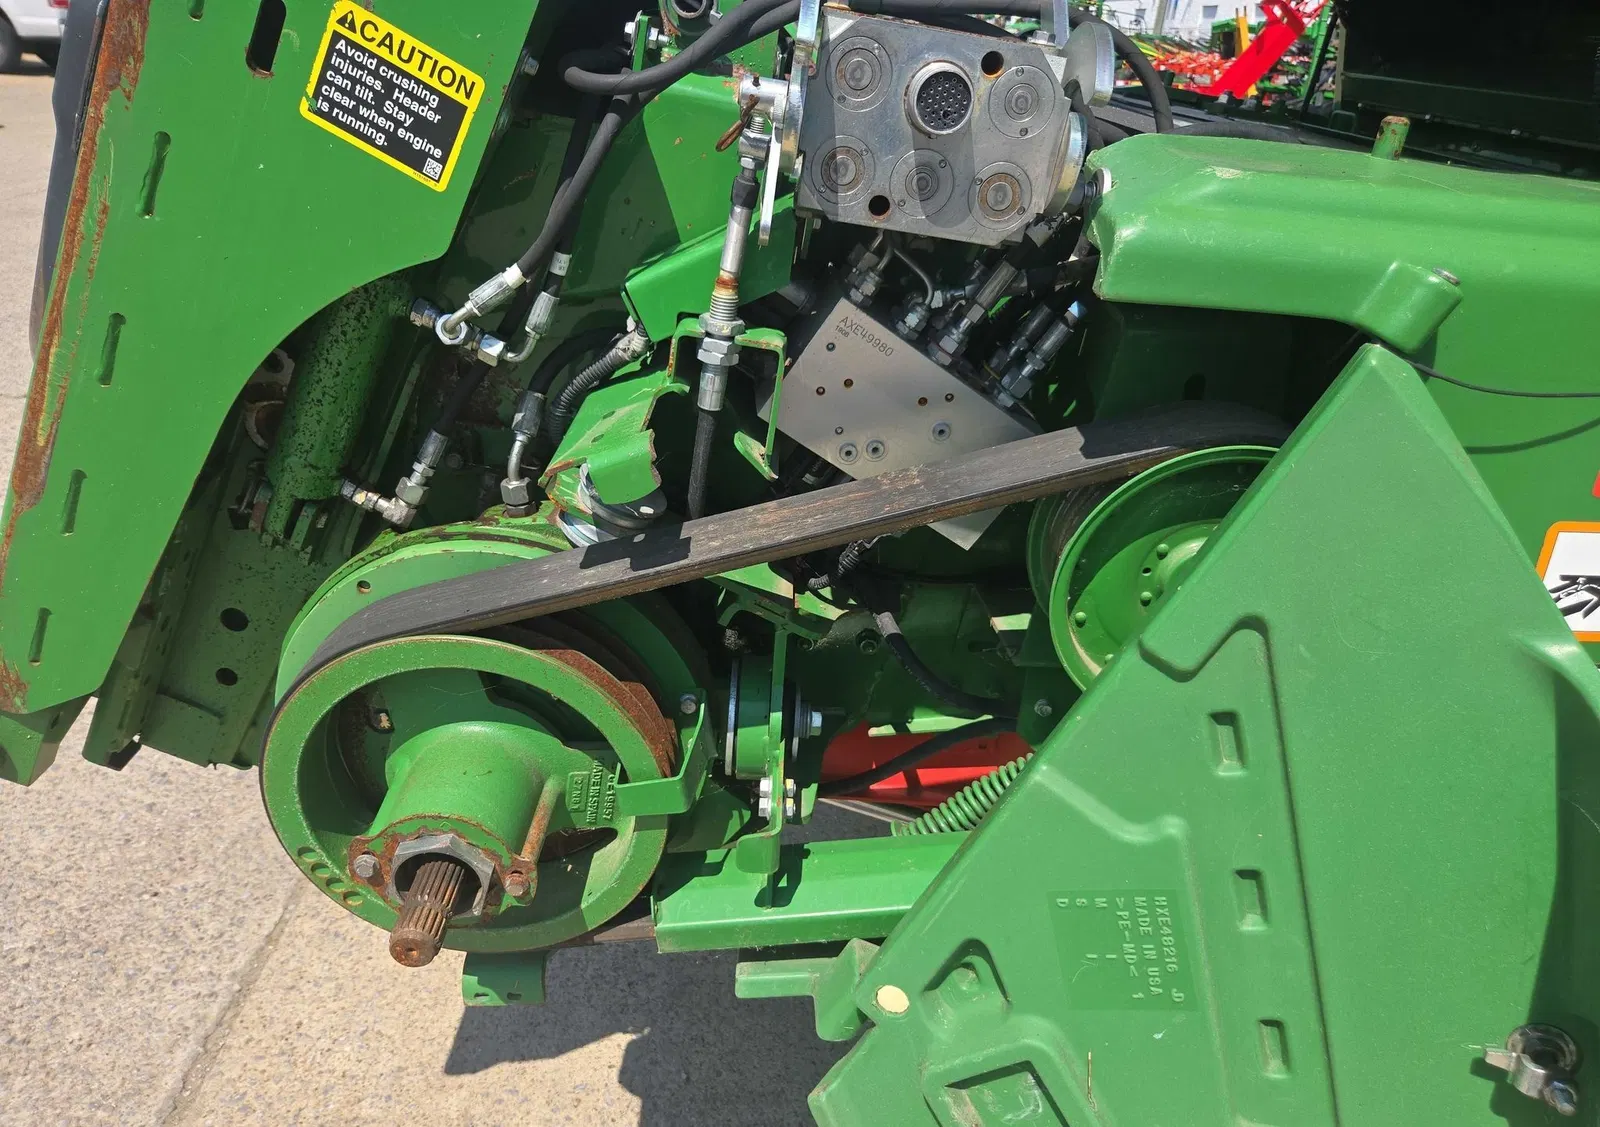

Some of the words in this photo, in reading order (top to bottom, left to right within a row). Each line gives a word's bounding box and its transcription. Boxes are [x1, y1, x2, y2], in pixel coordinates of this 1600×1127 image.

[335, 39, 377, 70] Avoid
[379, 65, 439, 108] crushing
[360, 20, 476, 100] CAUTION
[326, 70, 351, 91] can
[354, 85, 376, 105] tilt.
[383, 101, 414, 128] Stay
[331, 52, 386, 94] injuries.
[393, 88, 442, 124] Header
[317, 96, 329, 112] is
[332, 108, 388, 146] running.
[321, 84, 356, 110] clear
[358, 105, 394, 132] when
[397, 130, 442, 159] engine
[839, 316, 894, 357] AXE49980
[586, 796, 599, 822] SPAIN
[1056, 898, 1069, 907] D
[1094, 898, 1108, 908] M
[1134, 896, 1153, 936] MADE
[1142, 944, 1158, 960] IN
[1154, 896, 1179, 973] HXE48216
[1147, 967, 1163, 996] USA
